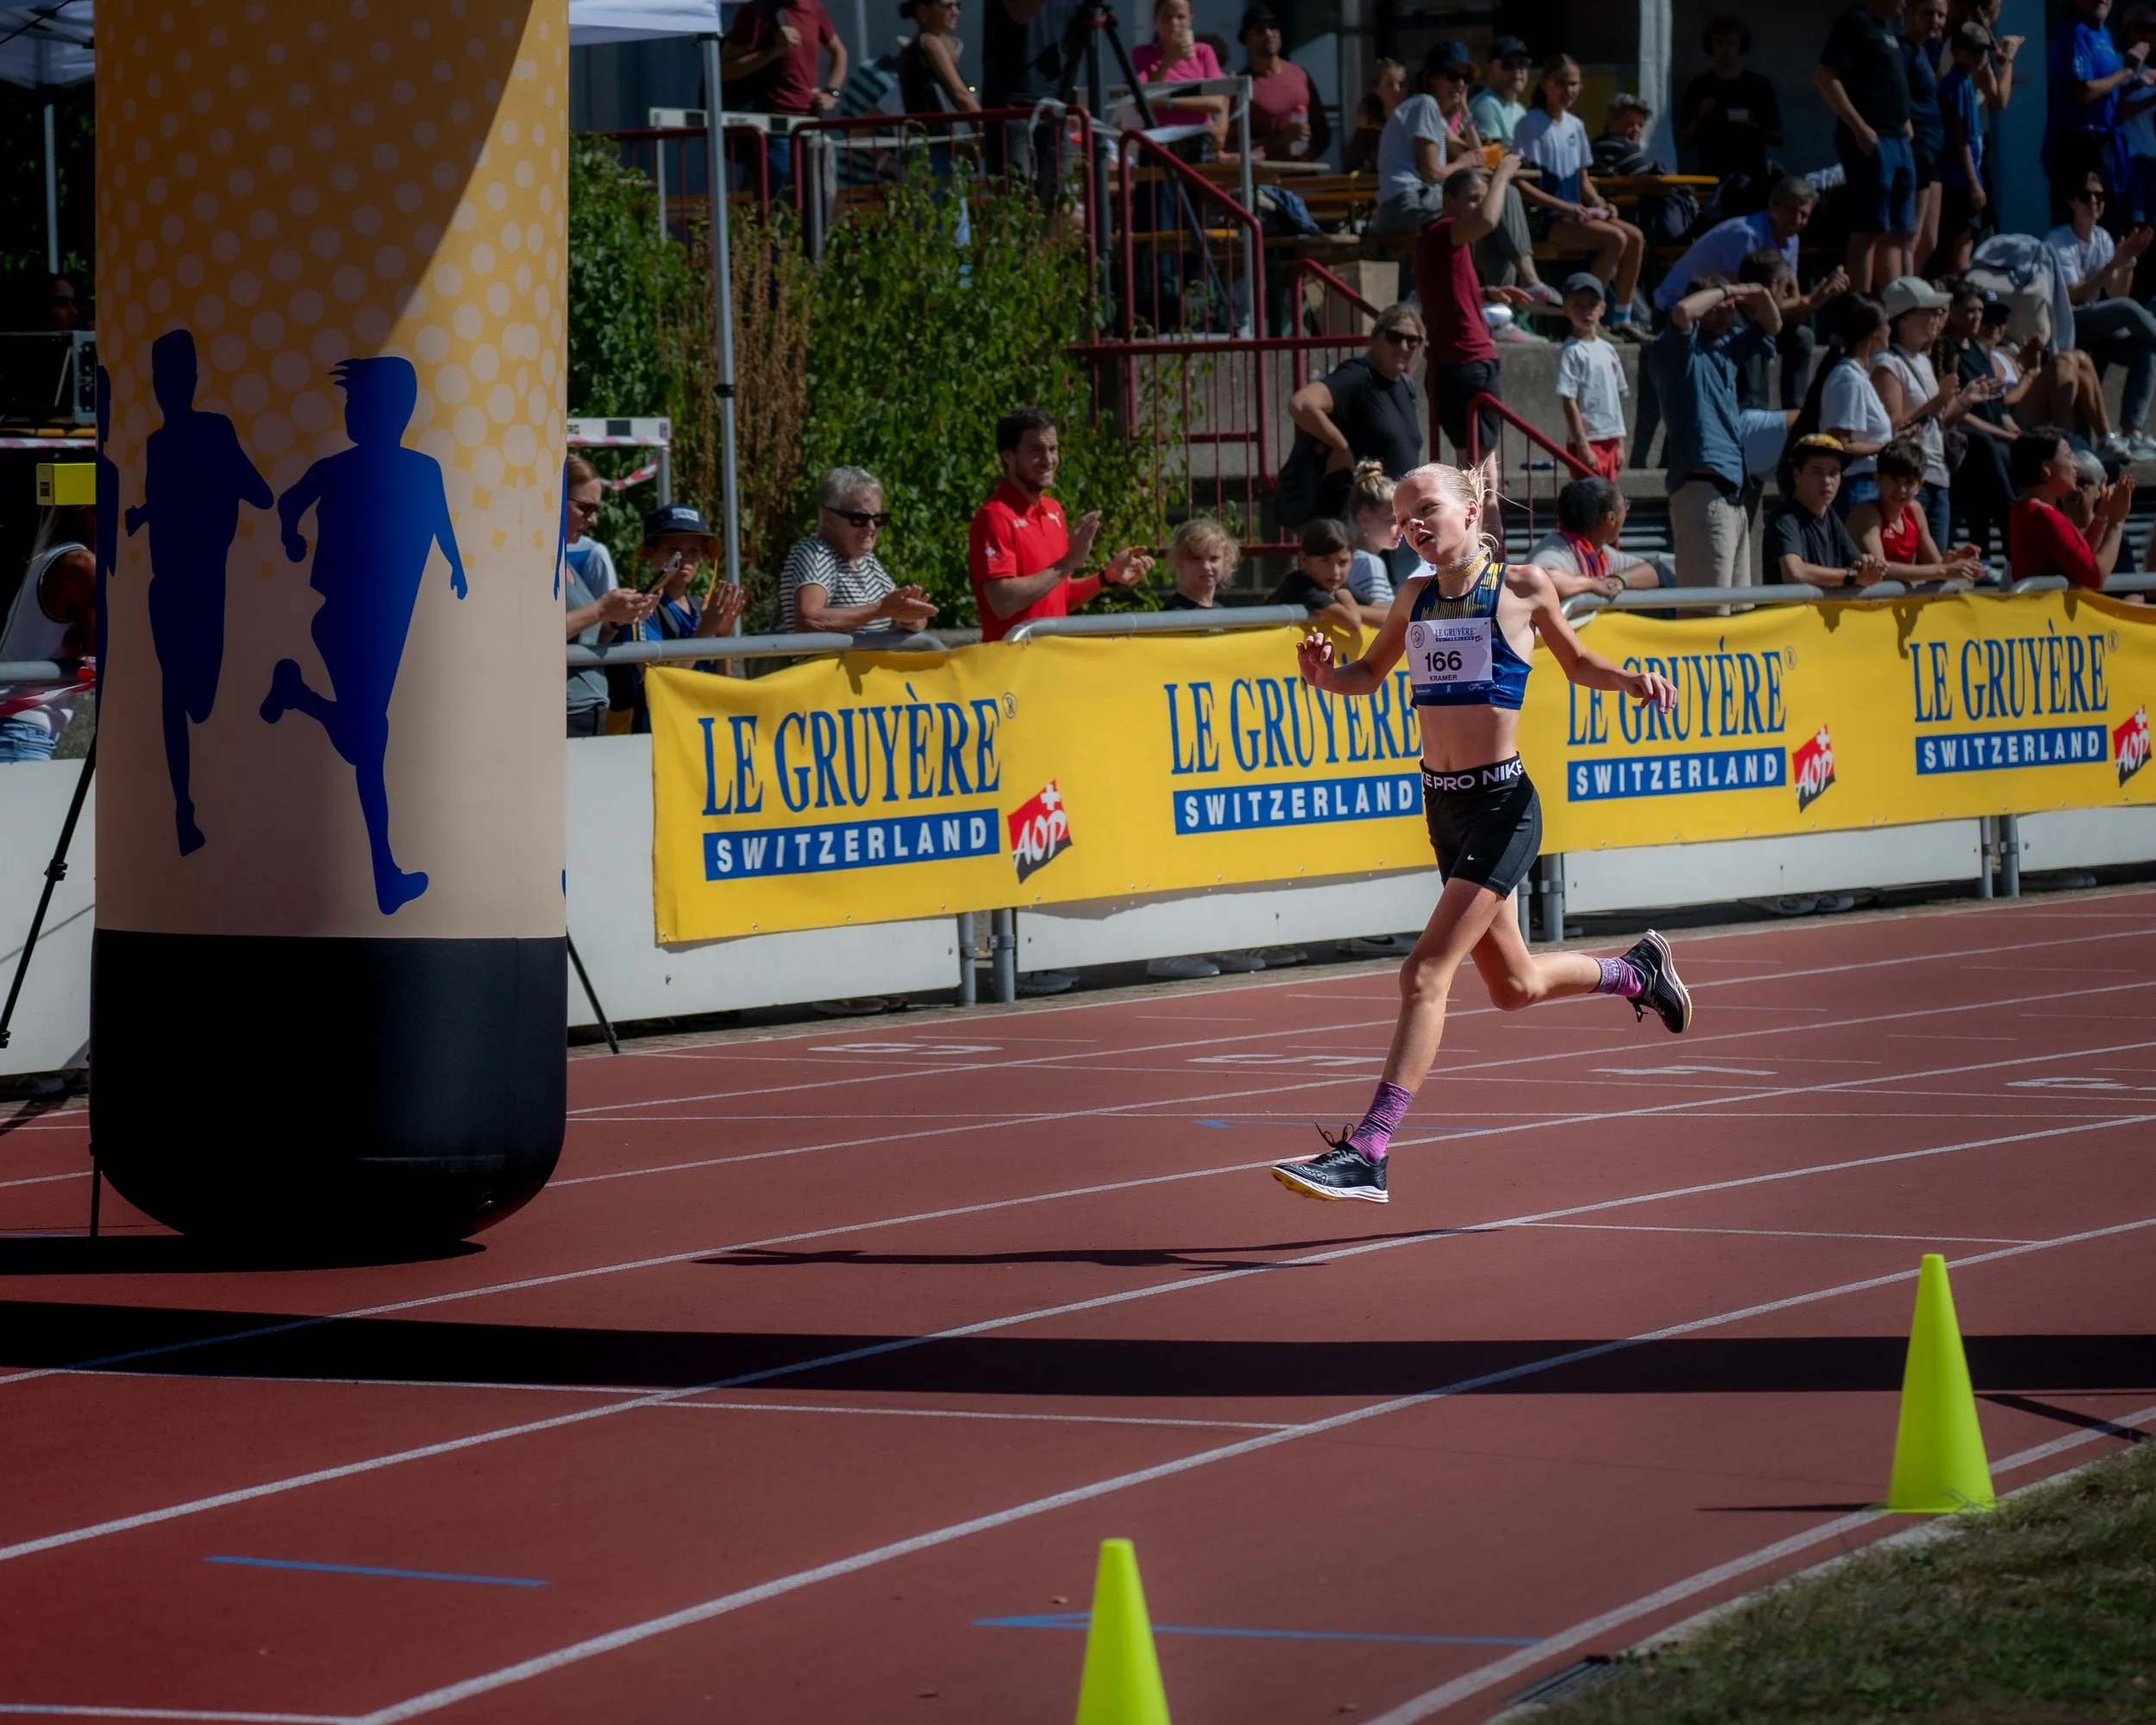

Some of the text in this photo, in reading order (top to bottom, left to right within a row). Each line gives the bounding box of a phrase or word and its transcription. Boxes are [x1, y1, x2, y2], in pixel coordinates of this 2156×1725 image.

[1425, 651, 1463, 672] 166
[1908, 642, 1953, 723] LE
[1163, 681, 1219, 775] LE
[1567, 680, 1608, 746] LE
[698, 716, 764, 816] LE
[1482, 759, 1524, 785] NIKE
[1576, 753, 1777, 796] SWITZERLAND
[1924, 730, 2100, 769] SWITZERLAND
[2115, 728, 2150, 776] AOP
[1795, 750, 1833, 800] AOP
[1184, 780, 1413, 827] SWITZERLAND
[716, 816, 987, 873] SWITZERLAND
[1012, 809, 1067, 870] AOP
